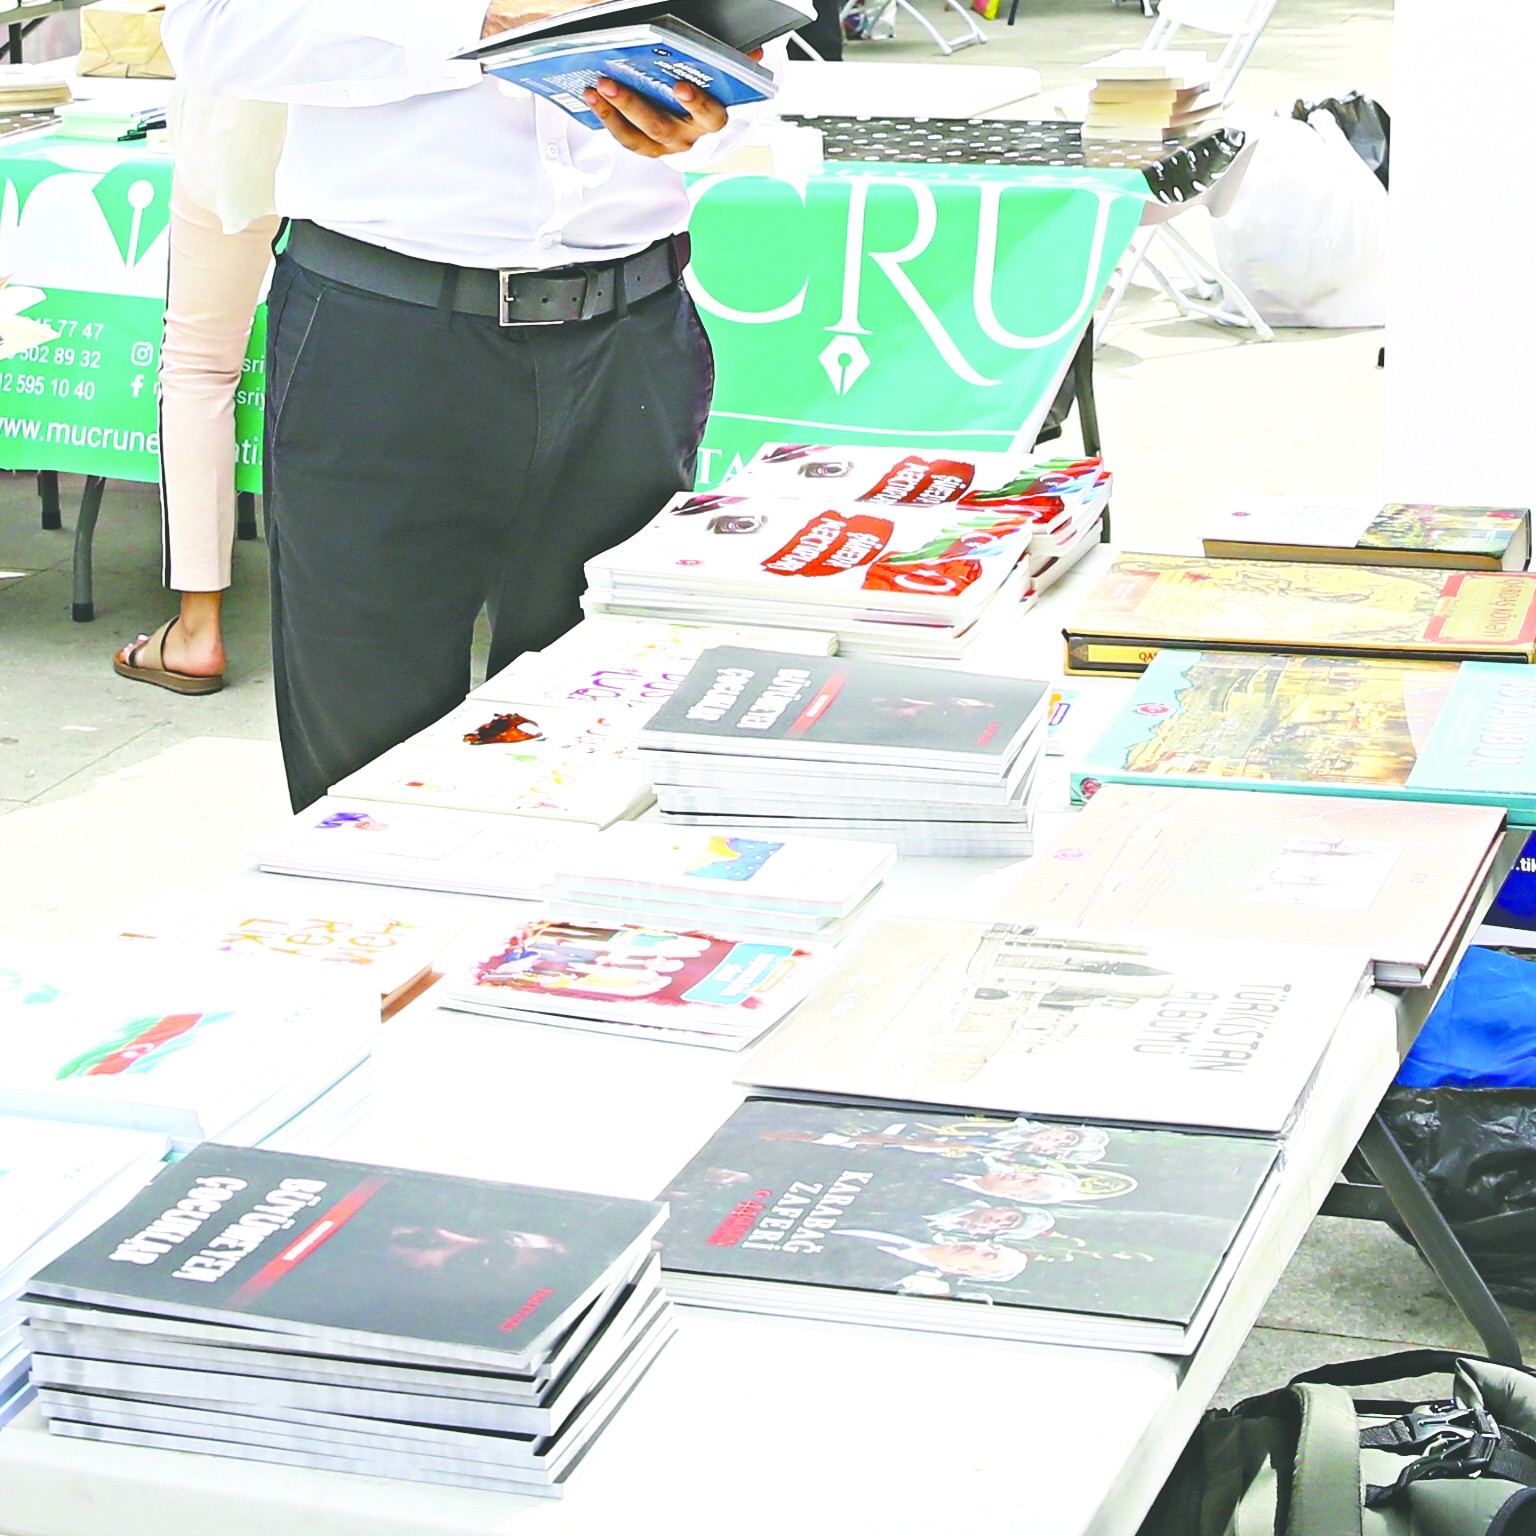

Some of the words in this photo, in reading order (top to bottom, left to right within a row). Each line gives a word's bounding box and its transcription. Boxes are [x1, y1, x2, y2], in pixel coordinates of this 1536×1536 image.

[54, 347, 75, 366] 89
[80, 350, 102, 368] 32
[58, 320, 80, 338] 77
[83, 322, 105, 341] 47
[16, 373, 44, 395] 595
[51, 378, 70, 398] 10
[73, 379, 96, 400] 40
[1139, 651, 1158, 663] QA
[1189, 983, 1293, 1073] TÜRKİSTAN
[107, 1174, 249, 1266] ÇOCUKLAR
[172, 1176, 329, 1284] BÜYÜMEYEN
[741, 1180, 824, 1252] ZAFERİ
[781, 1168, 875, 1255] KARABAĞ
